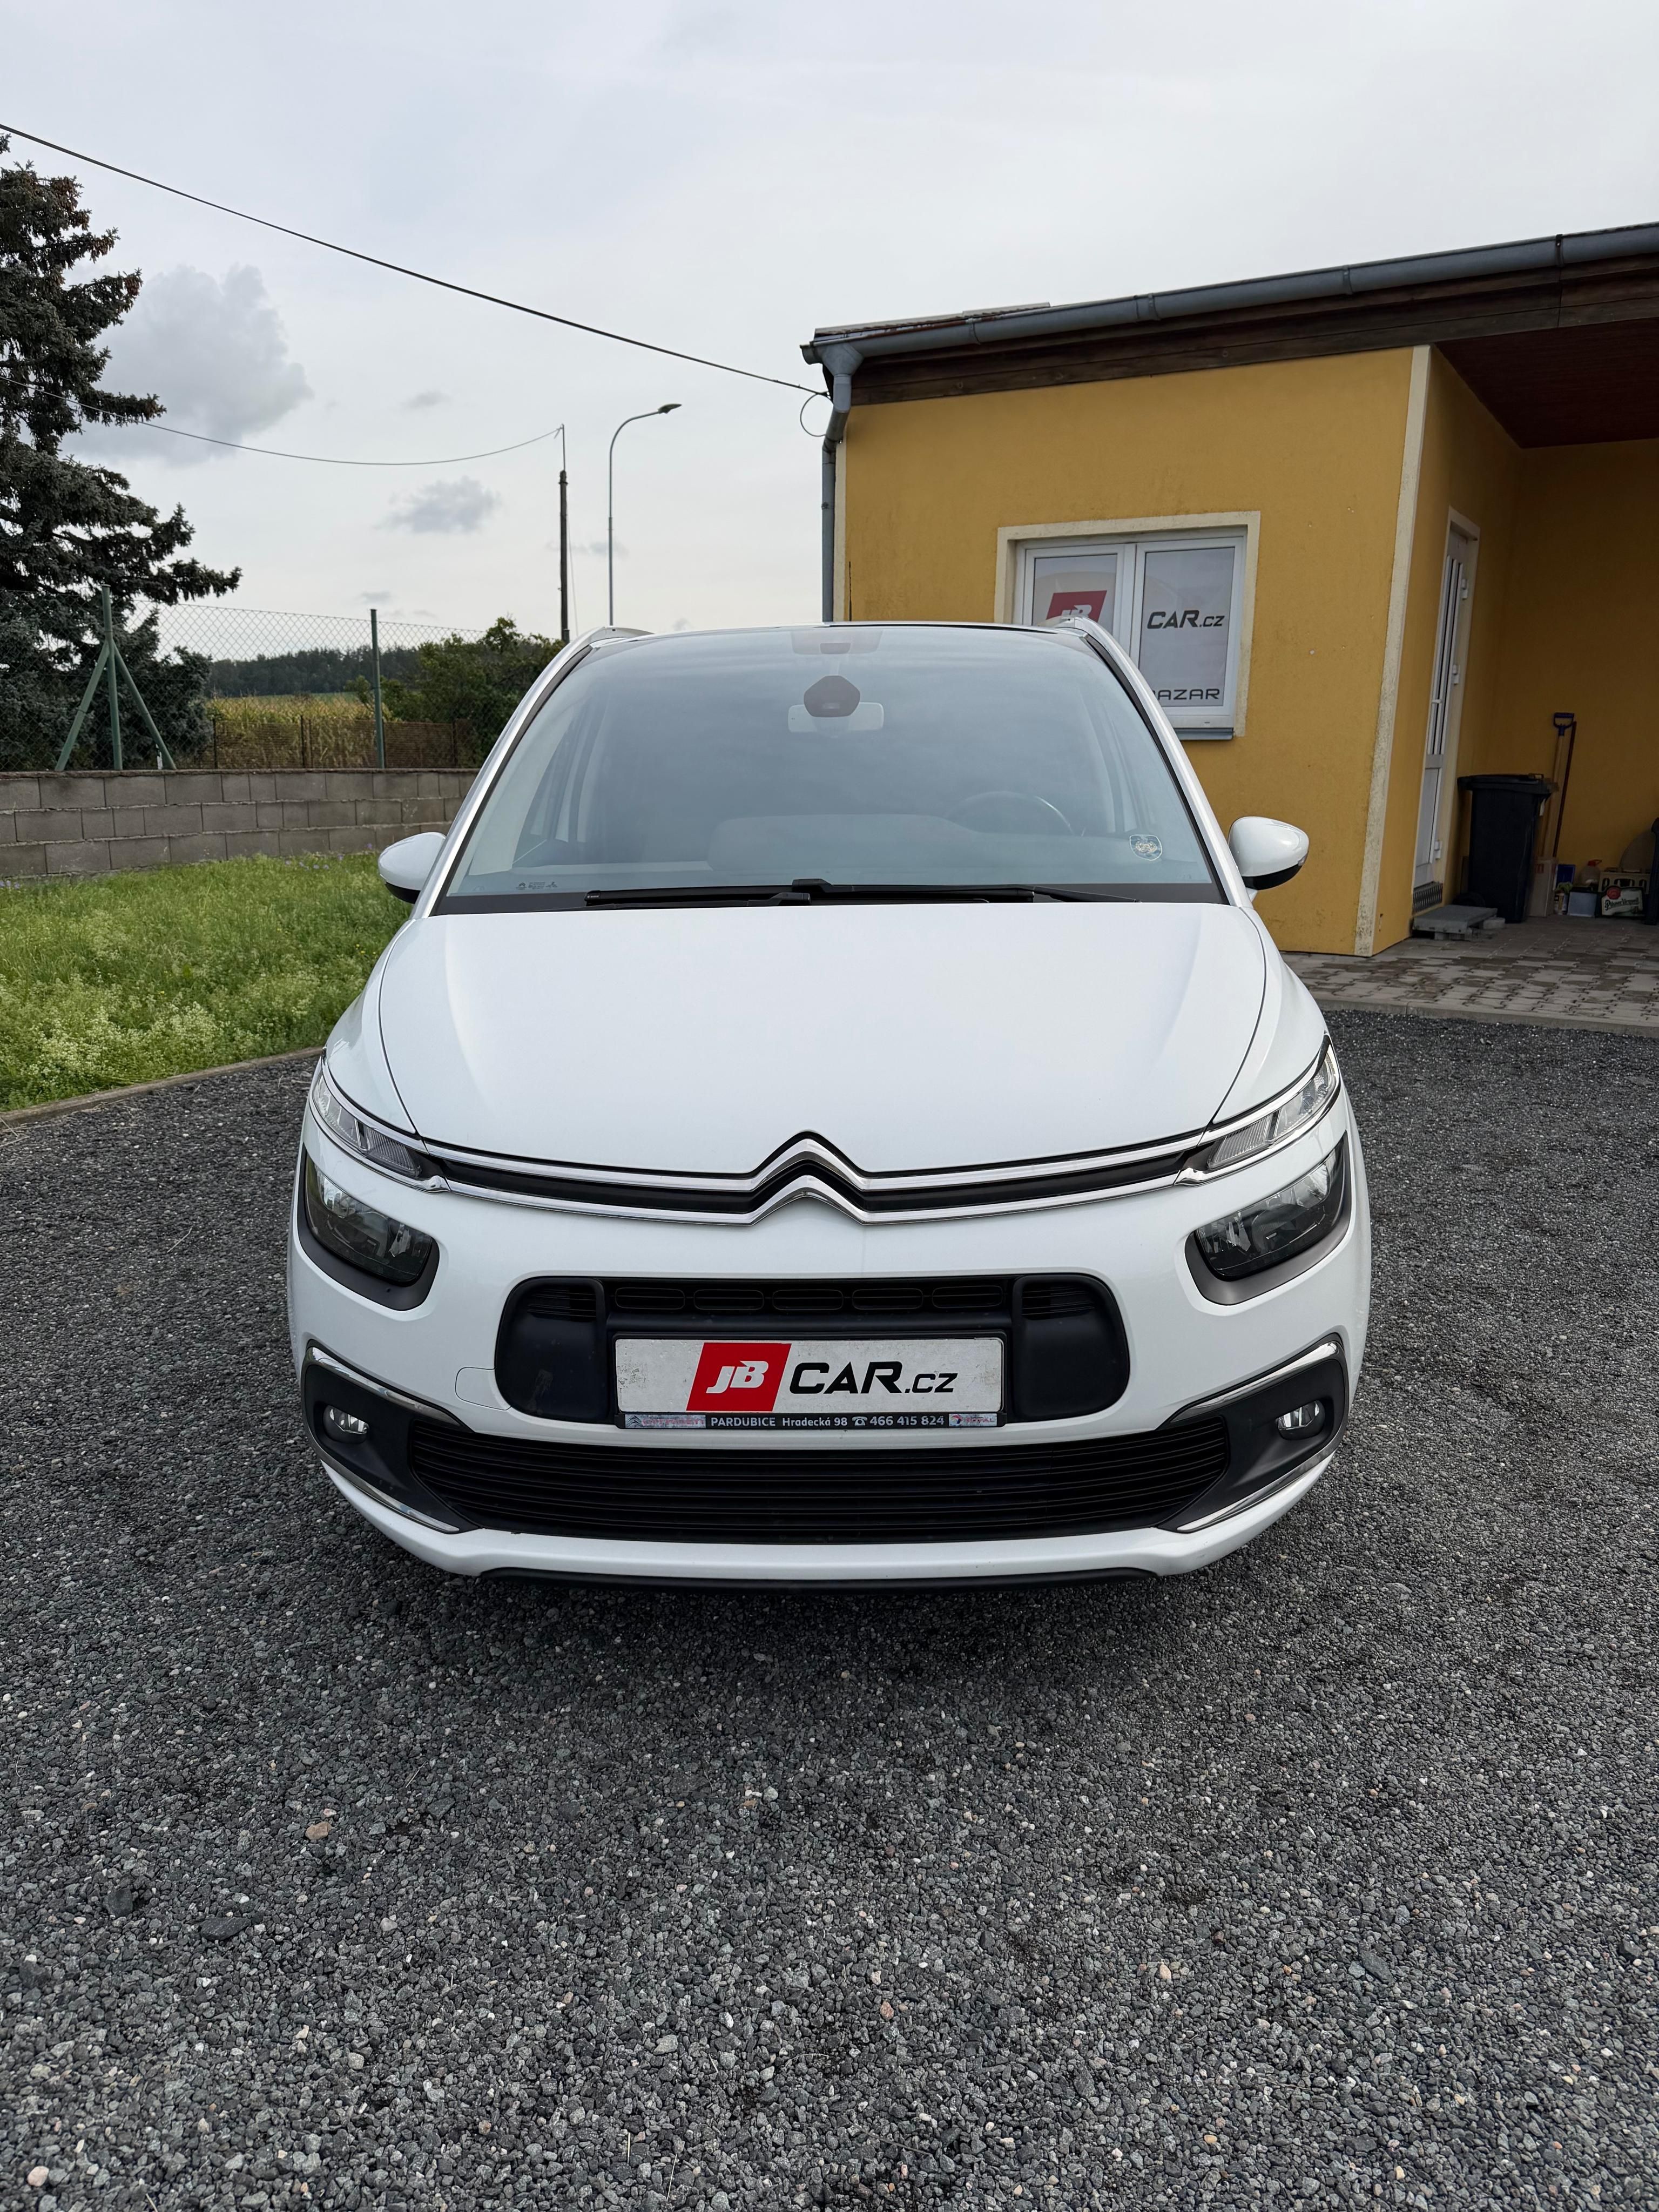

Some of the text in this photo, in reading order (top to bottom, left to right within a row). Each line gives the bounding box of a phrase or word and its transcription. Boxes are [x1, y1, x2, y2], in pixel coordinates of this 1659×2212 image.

[1152, 689, 1220, 700] AZAR
[706, 1360, 769, 1394] JB
[711, 1415, 945, 1426] PARDUBICE Hradecká 98 466 415 824
